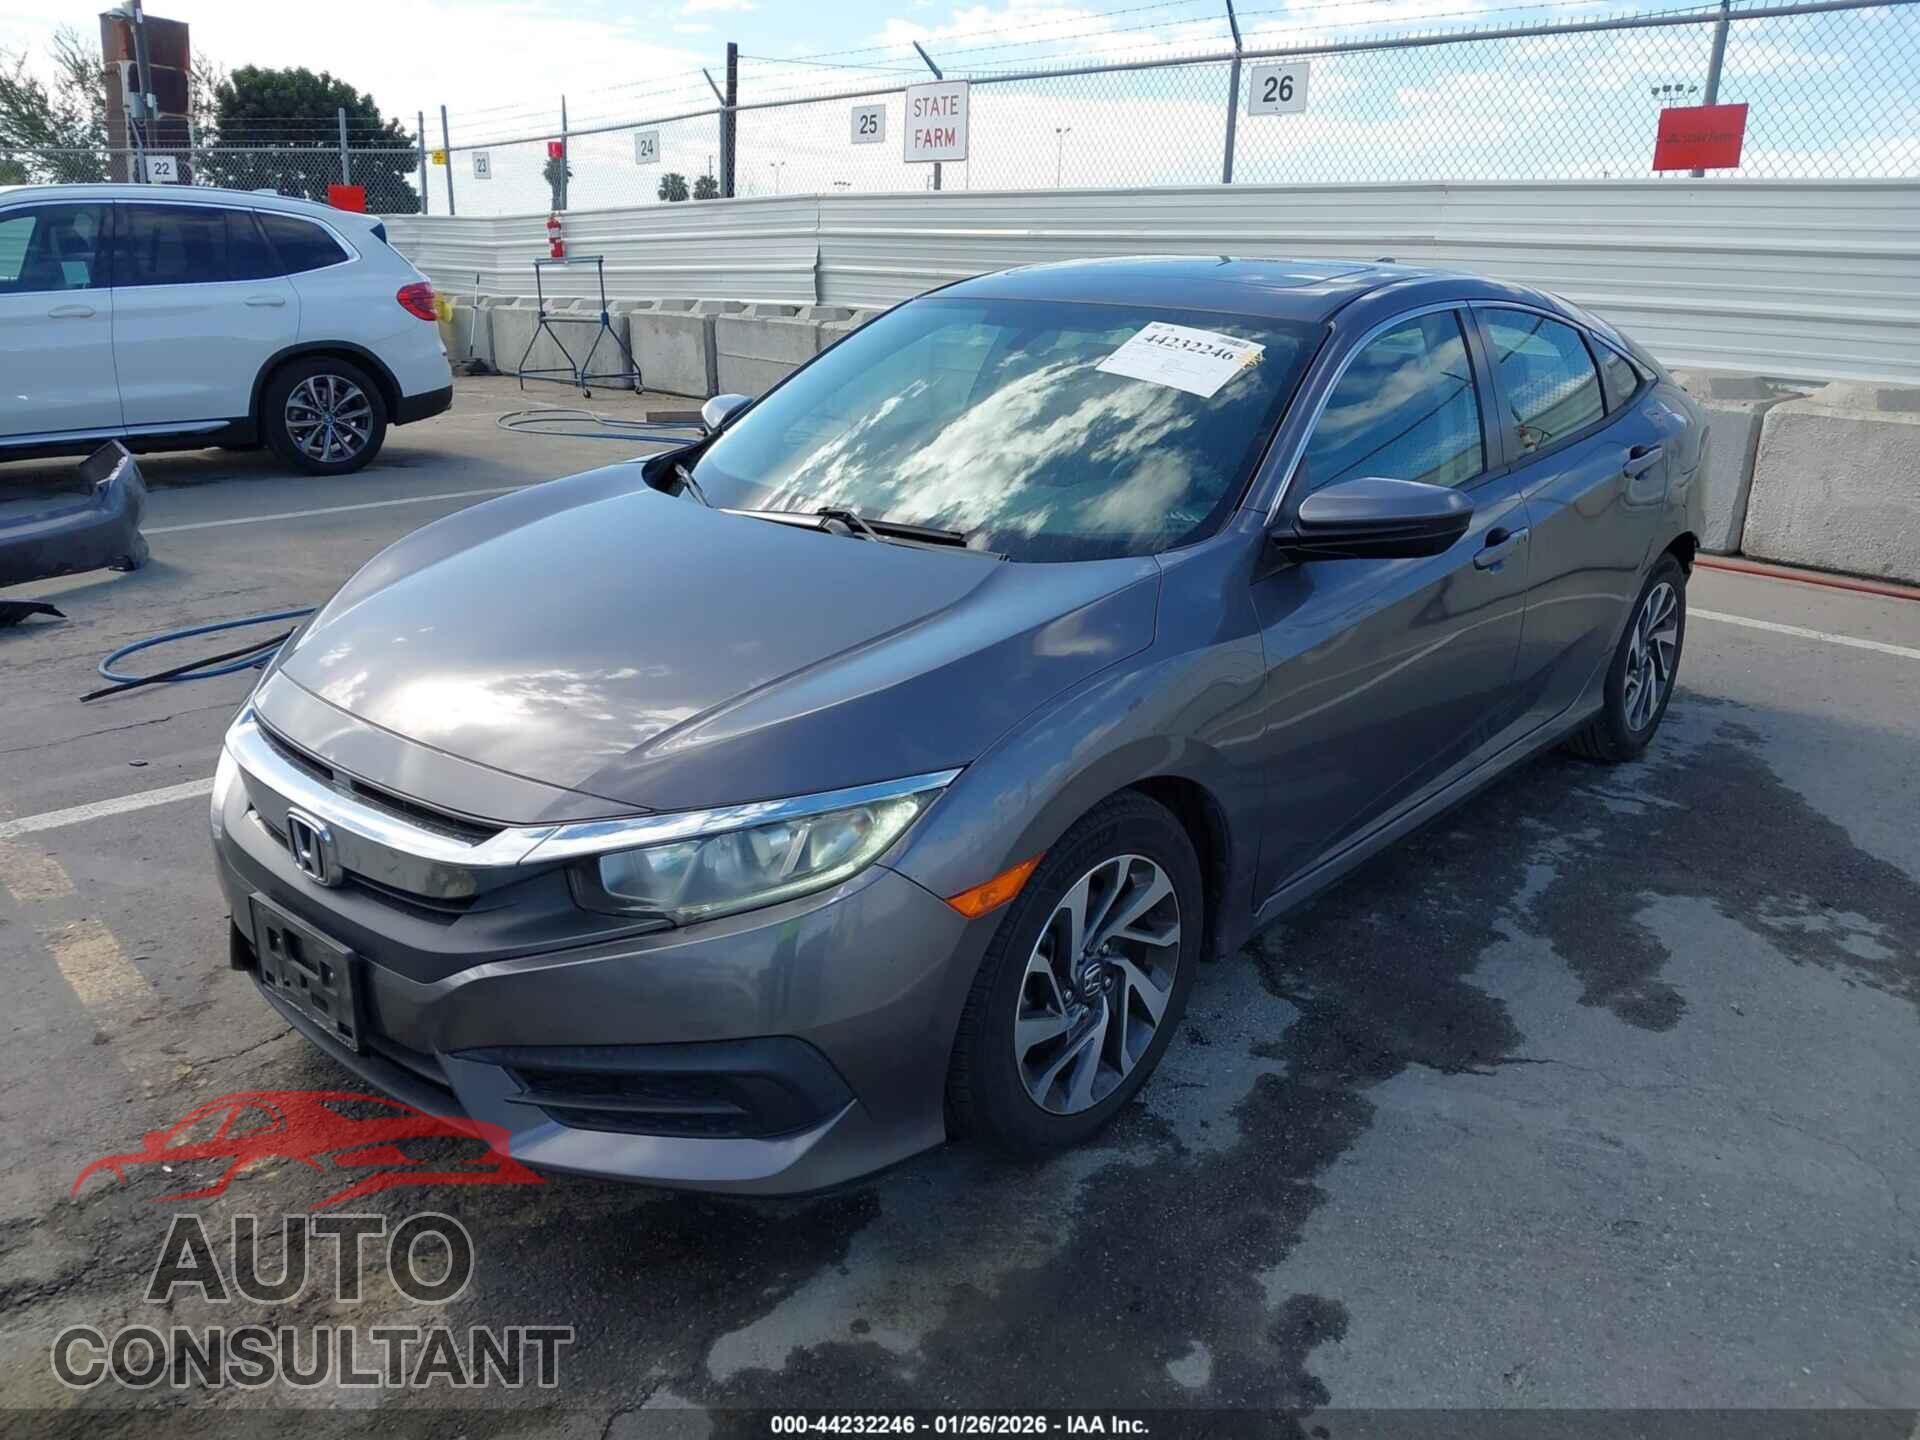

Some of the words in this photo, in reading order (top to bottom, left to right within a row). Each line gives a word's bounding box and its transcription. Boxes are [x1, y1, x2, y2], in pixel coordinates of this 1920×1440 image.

[1262, 75, 1294, 103] 26
[914, 95, 959, 117] STATE
[860, 114, 877, 134] 25
[641, 139, 654, 156] 24
[914, 128, 956, 149] FARM
[154, 162, 170, 175] 22
[476, 158, 487, 173] 23
[1144, 334, 1235, 361] 44232246
